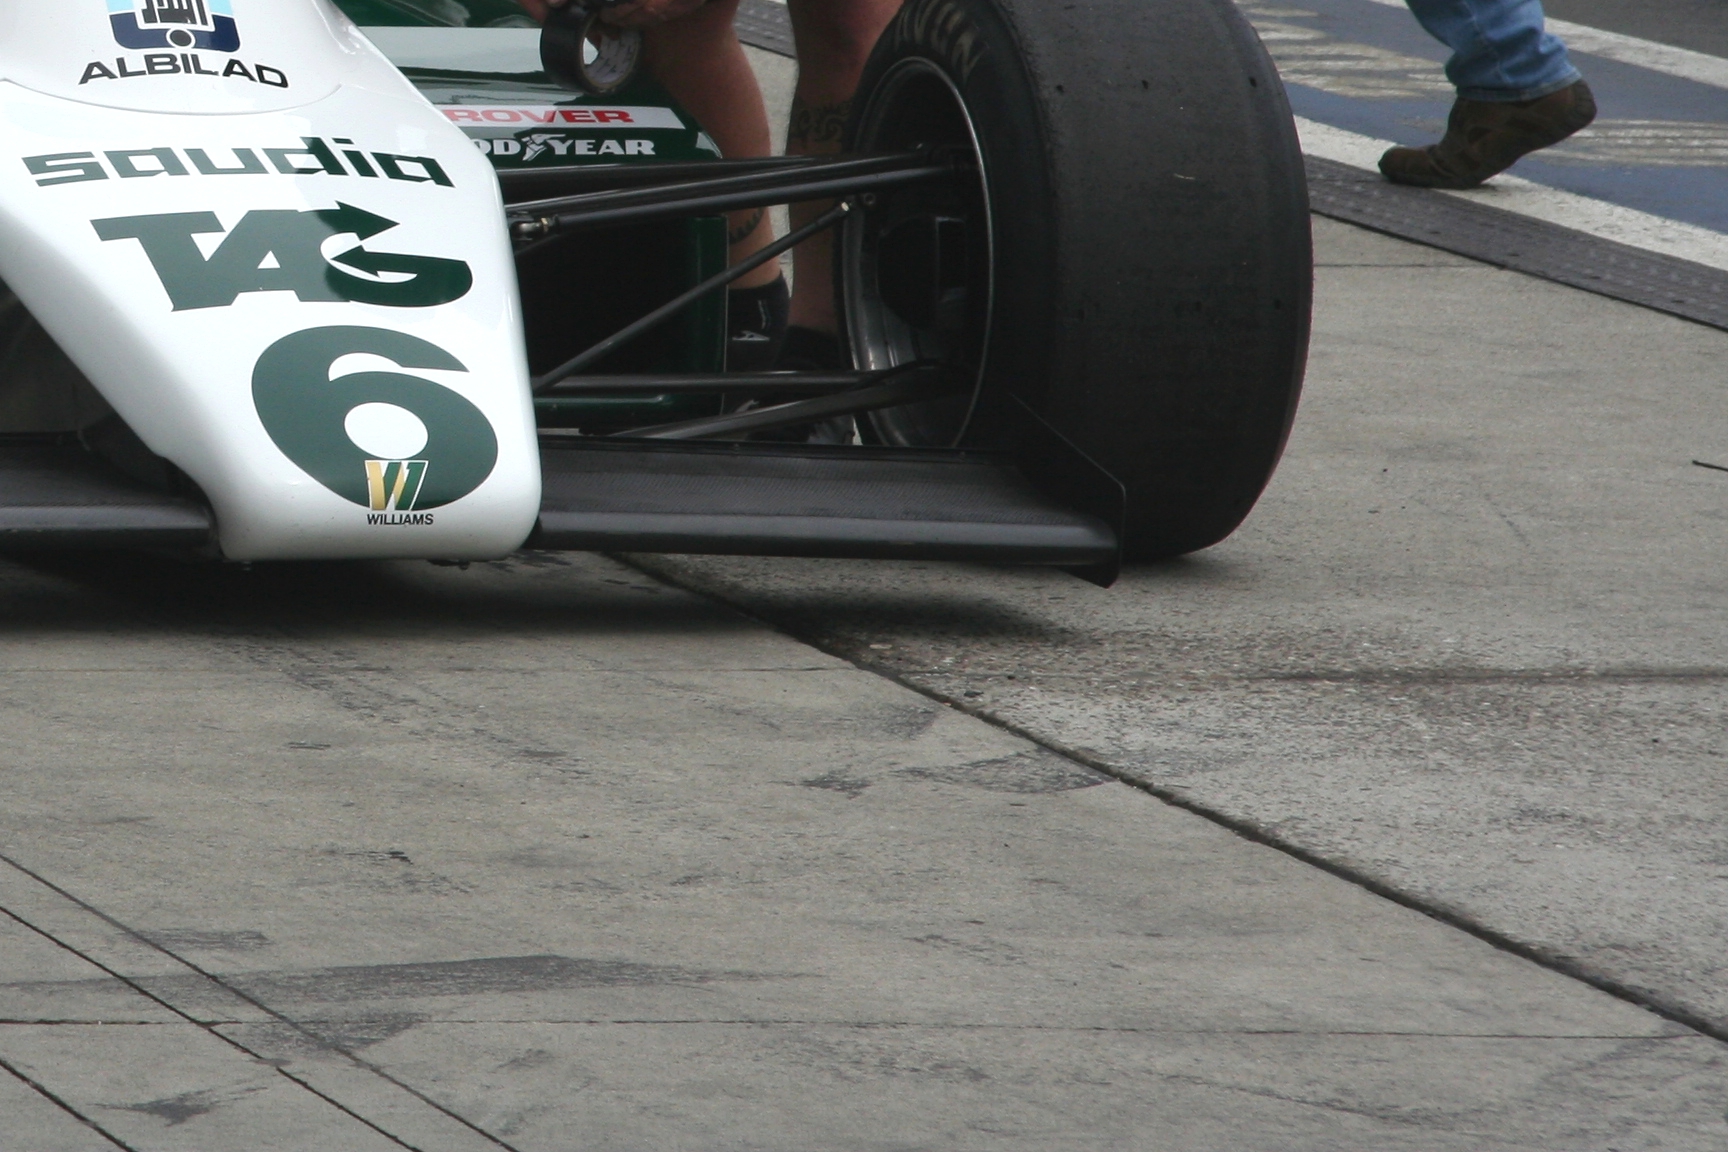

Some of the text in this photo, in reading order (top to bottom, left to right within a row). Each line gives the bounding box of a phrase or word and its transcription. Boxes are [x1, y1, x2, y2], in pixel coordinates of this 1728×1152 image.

[78, 53, 289, 88] ALBILAD
[443, 108, 635, 124] ROVER
[22, 137, 456, 188] saudia
[91, 201, 473, 312] TAG
[251, 324, 499, 511] 6
[367, 514, 434, 525] WILLIAMS
